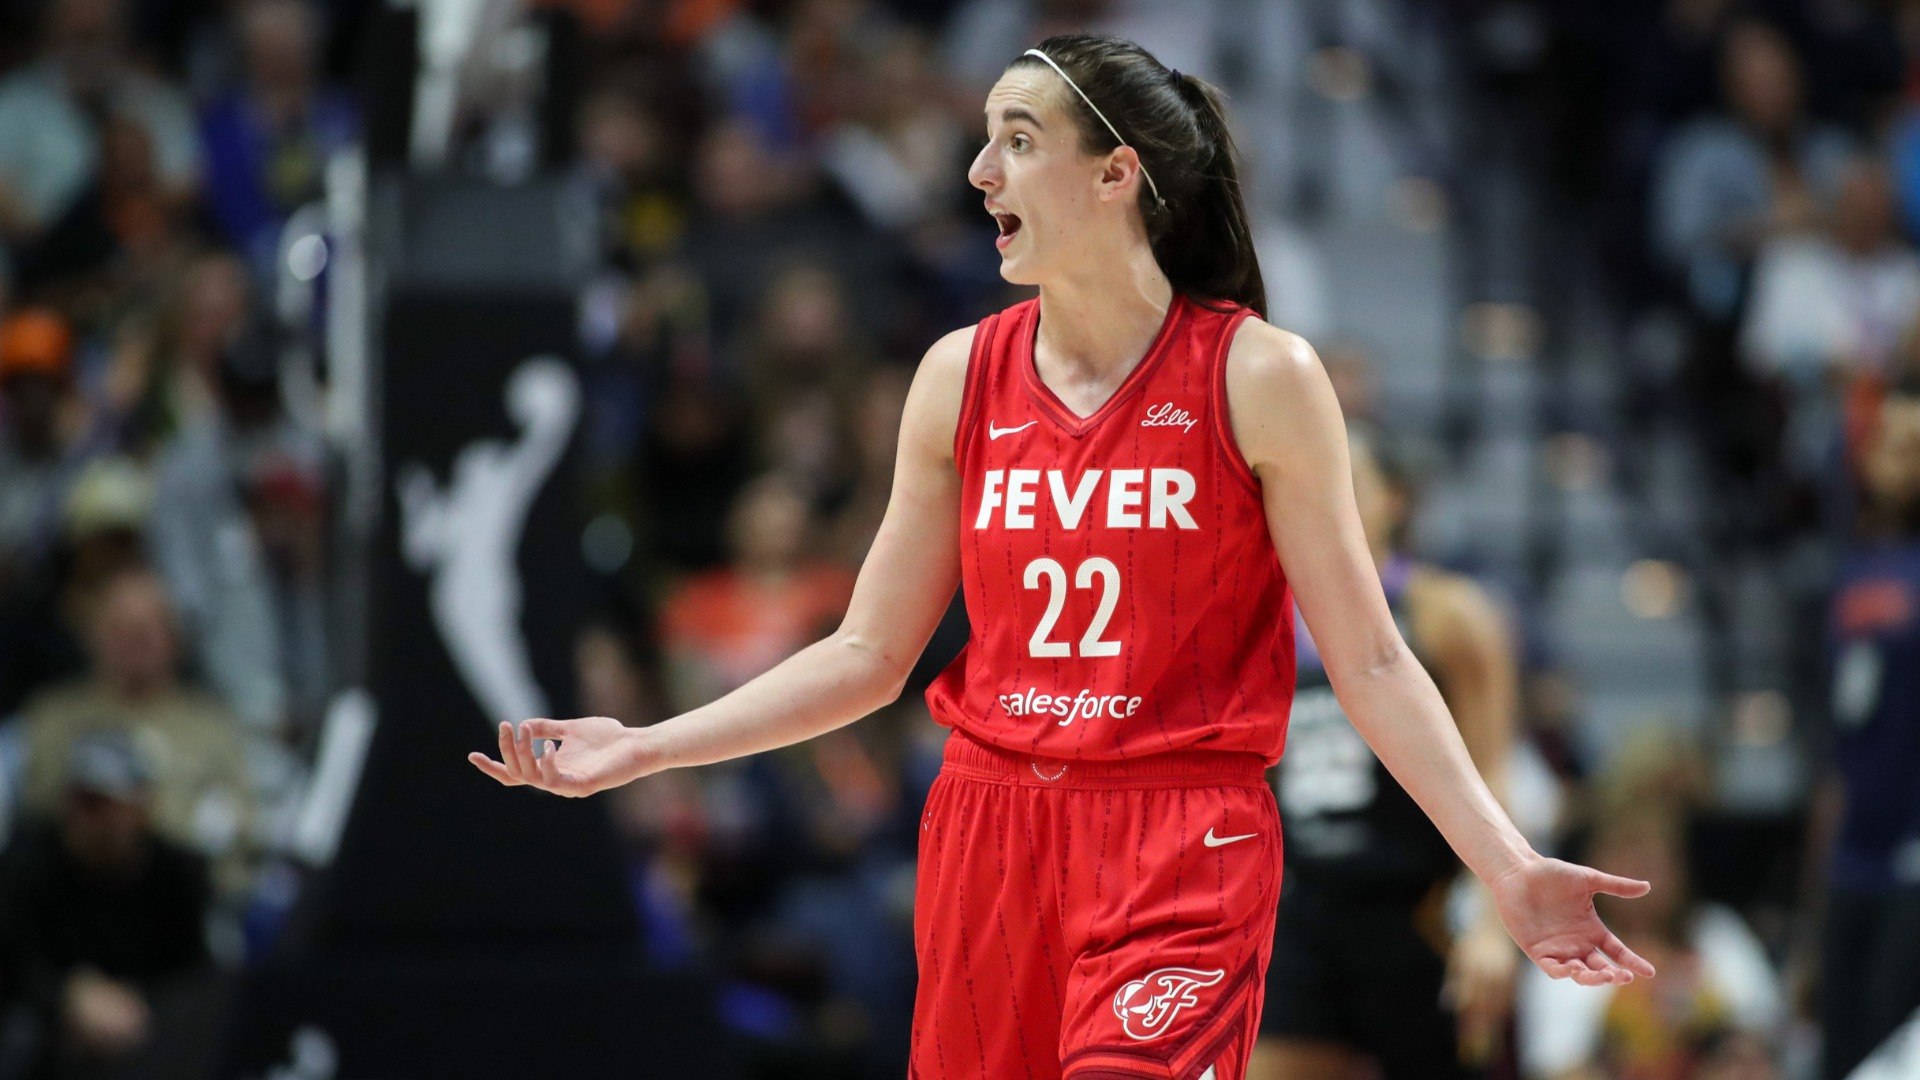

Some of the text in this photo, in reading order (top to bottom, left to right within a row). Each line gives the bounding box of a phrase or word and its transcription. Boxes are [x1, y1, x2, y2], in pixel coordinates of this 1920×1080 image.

[1141, 402, 1198, 433] Lilly
[975, 468, 1199, 530] FEVER
[1022, 557, 1122, 658] 22
[999, 687, 1142, 726] salesforce
